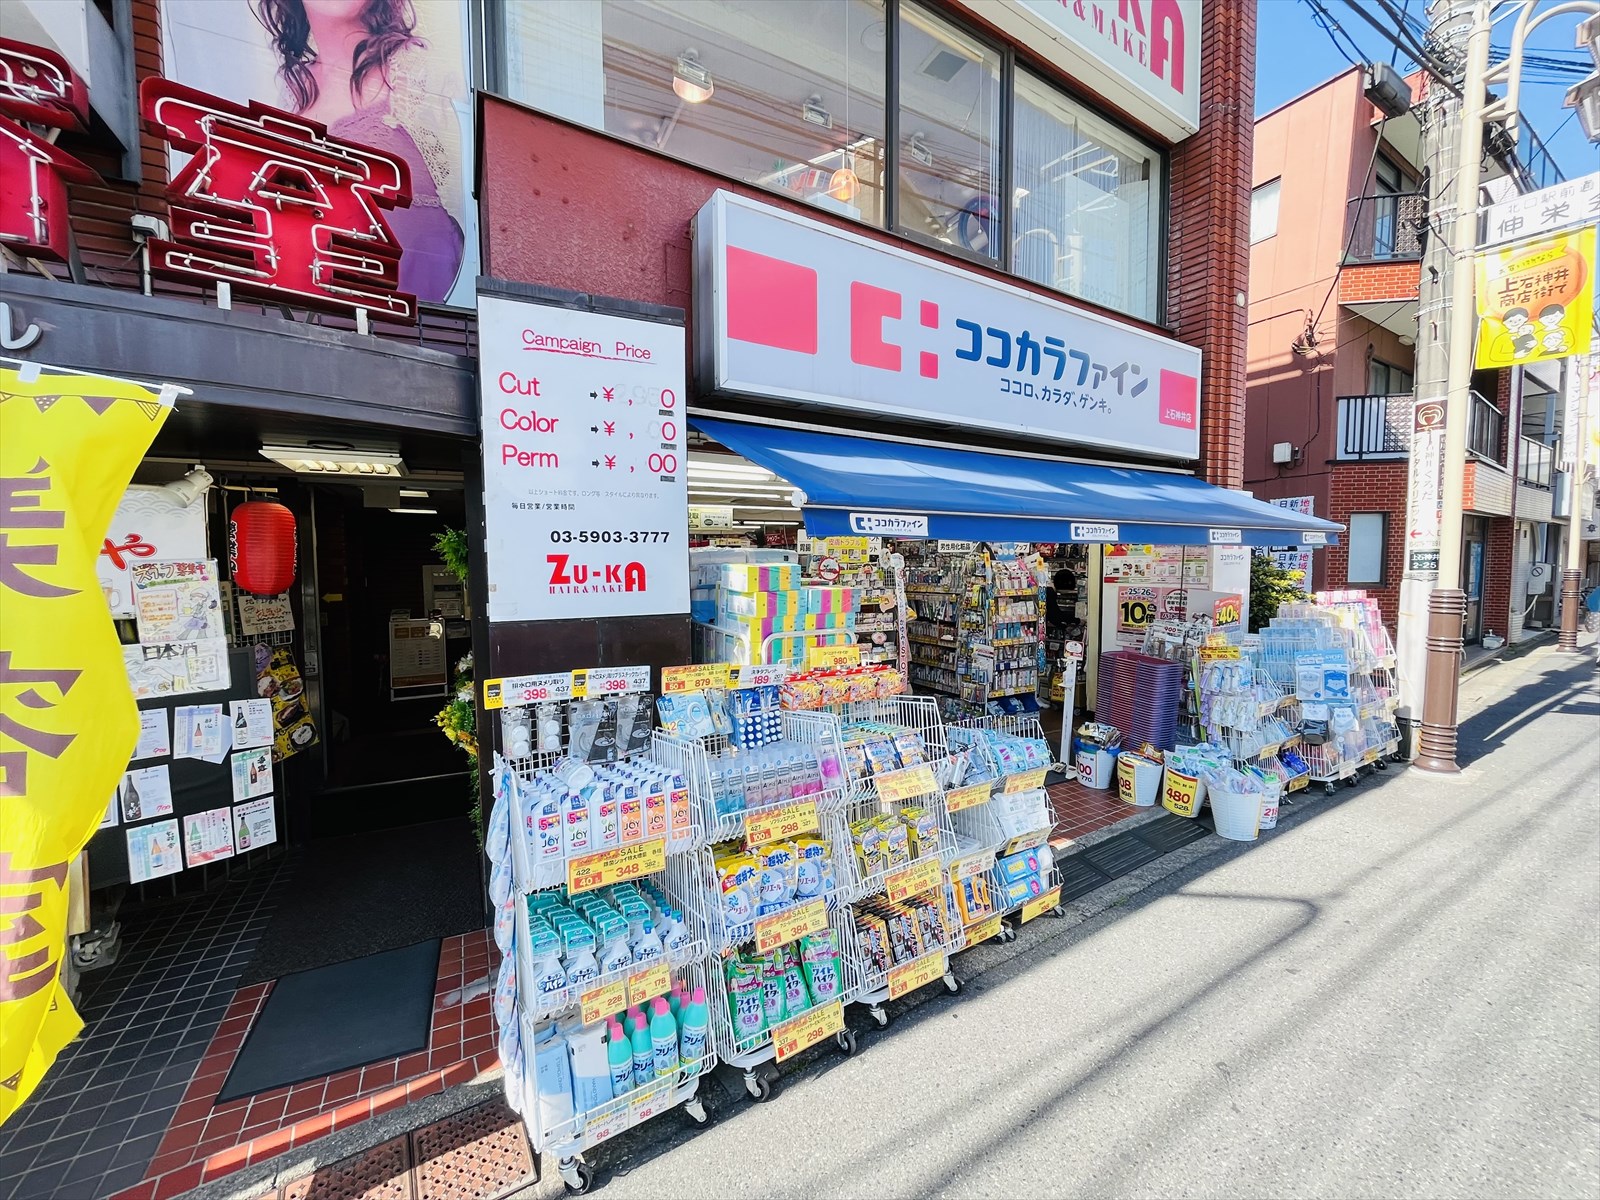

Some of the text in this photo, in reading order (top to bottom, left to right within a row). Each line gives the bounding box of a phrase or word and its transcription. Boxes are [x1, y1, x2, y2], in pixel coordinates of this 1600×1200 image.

[1497, 267, 1570, 294] 上石神井
[1500, 283, 1568, 308] 商店街で
[522, 329, 651, 359] Campaign Price
[955, 318, 1148, 398] ココカラファイン
[498, 371, 541, 397] Cut
[1000, 377, 1112, 415] ココロ、カラダ、ゲンキ。
[500, 407, 559, 433] Color
[1164, 407, 1192, 424] 上石神井店
[501, 443, 559, 468] Perm
[874, 517, 924, 528] ココカラファイン
[550, 530, 670, 543] 03-5903-3777
[1085, 526, 1116, 535] ココカラファイン
[1412, 561, 1437, 569] 2-25
[833, 656, 848, 665] 980
[605, 679, 626, 691] 398
[694, 678, 711, 687] 879
[753, 675, 769, 684] 189
[524, 688, 548, 700] 398
[1166, 787, 1191, 804] 480
[781, 805, 800, 815] SALE
[1174, 802, 1189, 811] 528
[650, 814, 665, 824] JOY
[673, 808, 688, 818] JOY
[623, 820, 640, 831] JOY
[781, 822, 799, 834] 298
[541, 836, 560, 848] JOY
[570, 830, 588, 842] JOY
[620, 844, 644, 856] SALE
[767, 852, 791, 867] 超特大
[575, 867, 591, 876] 422
[615, 863, 640, 878] 348
[735, 867, 756, 886] 超特大
[580, 878, 593, 887] 40
[798, 877, 816, 886] リエール
[914, 882, 928, 891] 898
[760, 882, 782, 894] アリエール
[728, 905, 748, 915] アリエール
[791, 906, 809, 917] SALE
[790, 923, 809, 937] 384
[915, 973, 929, 984] 770
[607, 995, 623, 1006] 228
[807, 1010, 825, 1023] SALE
[807, 1027, 824, 1042] 298
[639, 1108, 652, 1119] 98
[596, 1128, 610, 1140] 98
